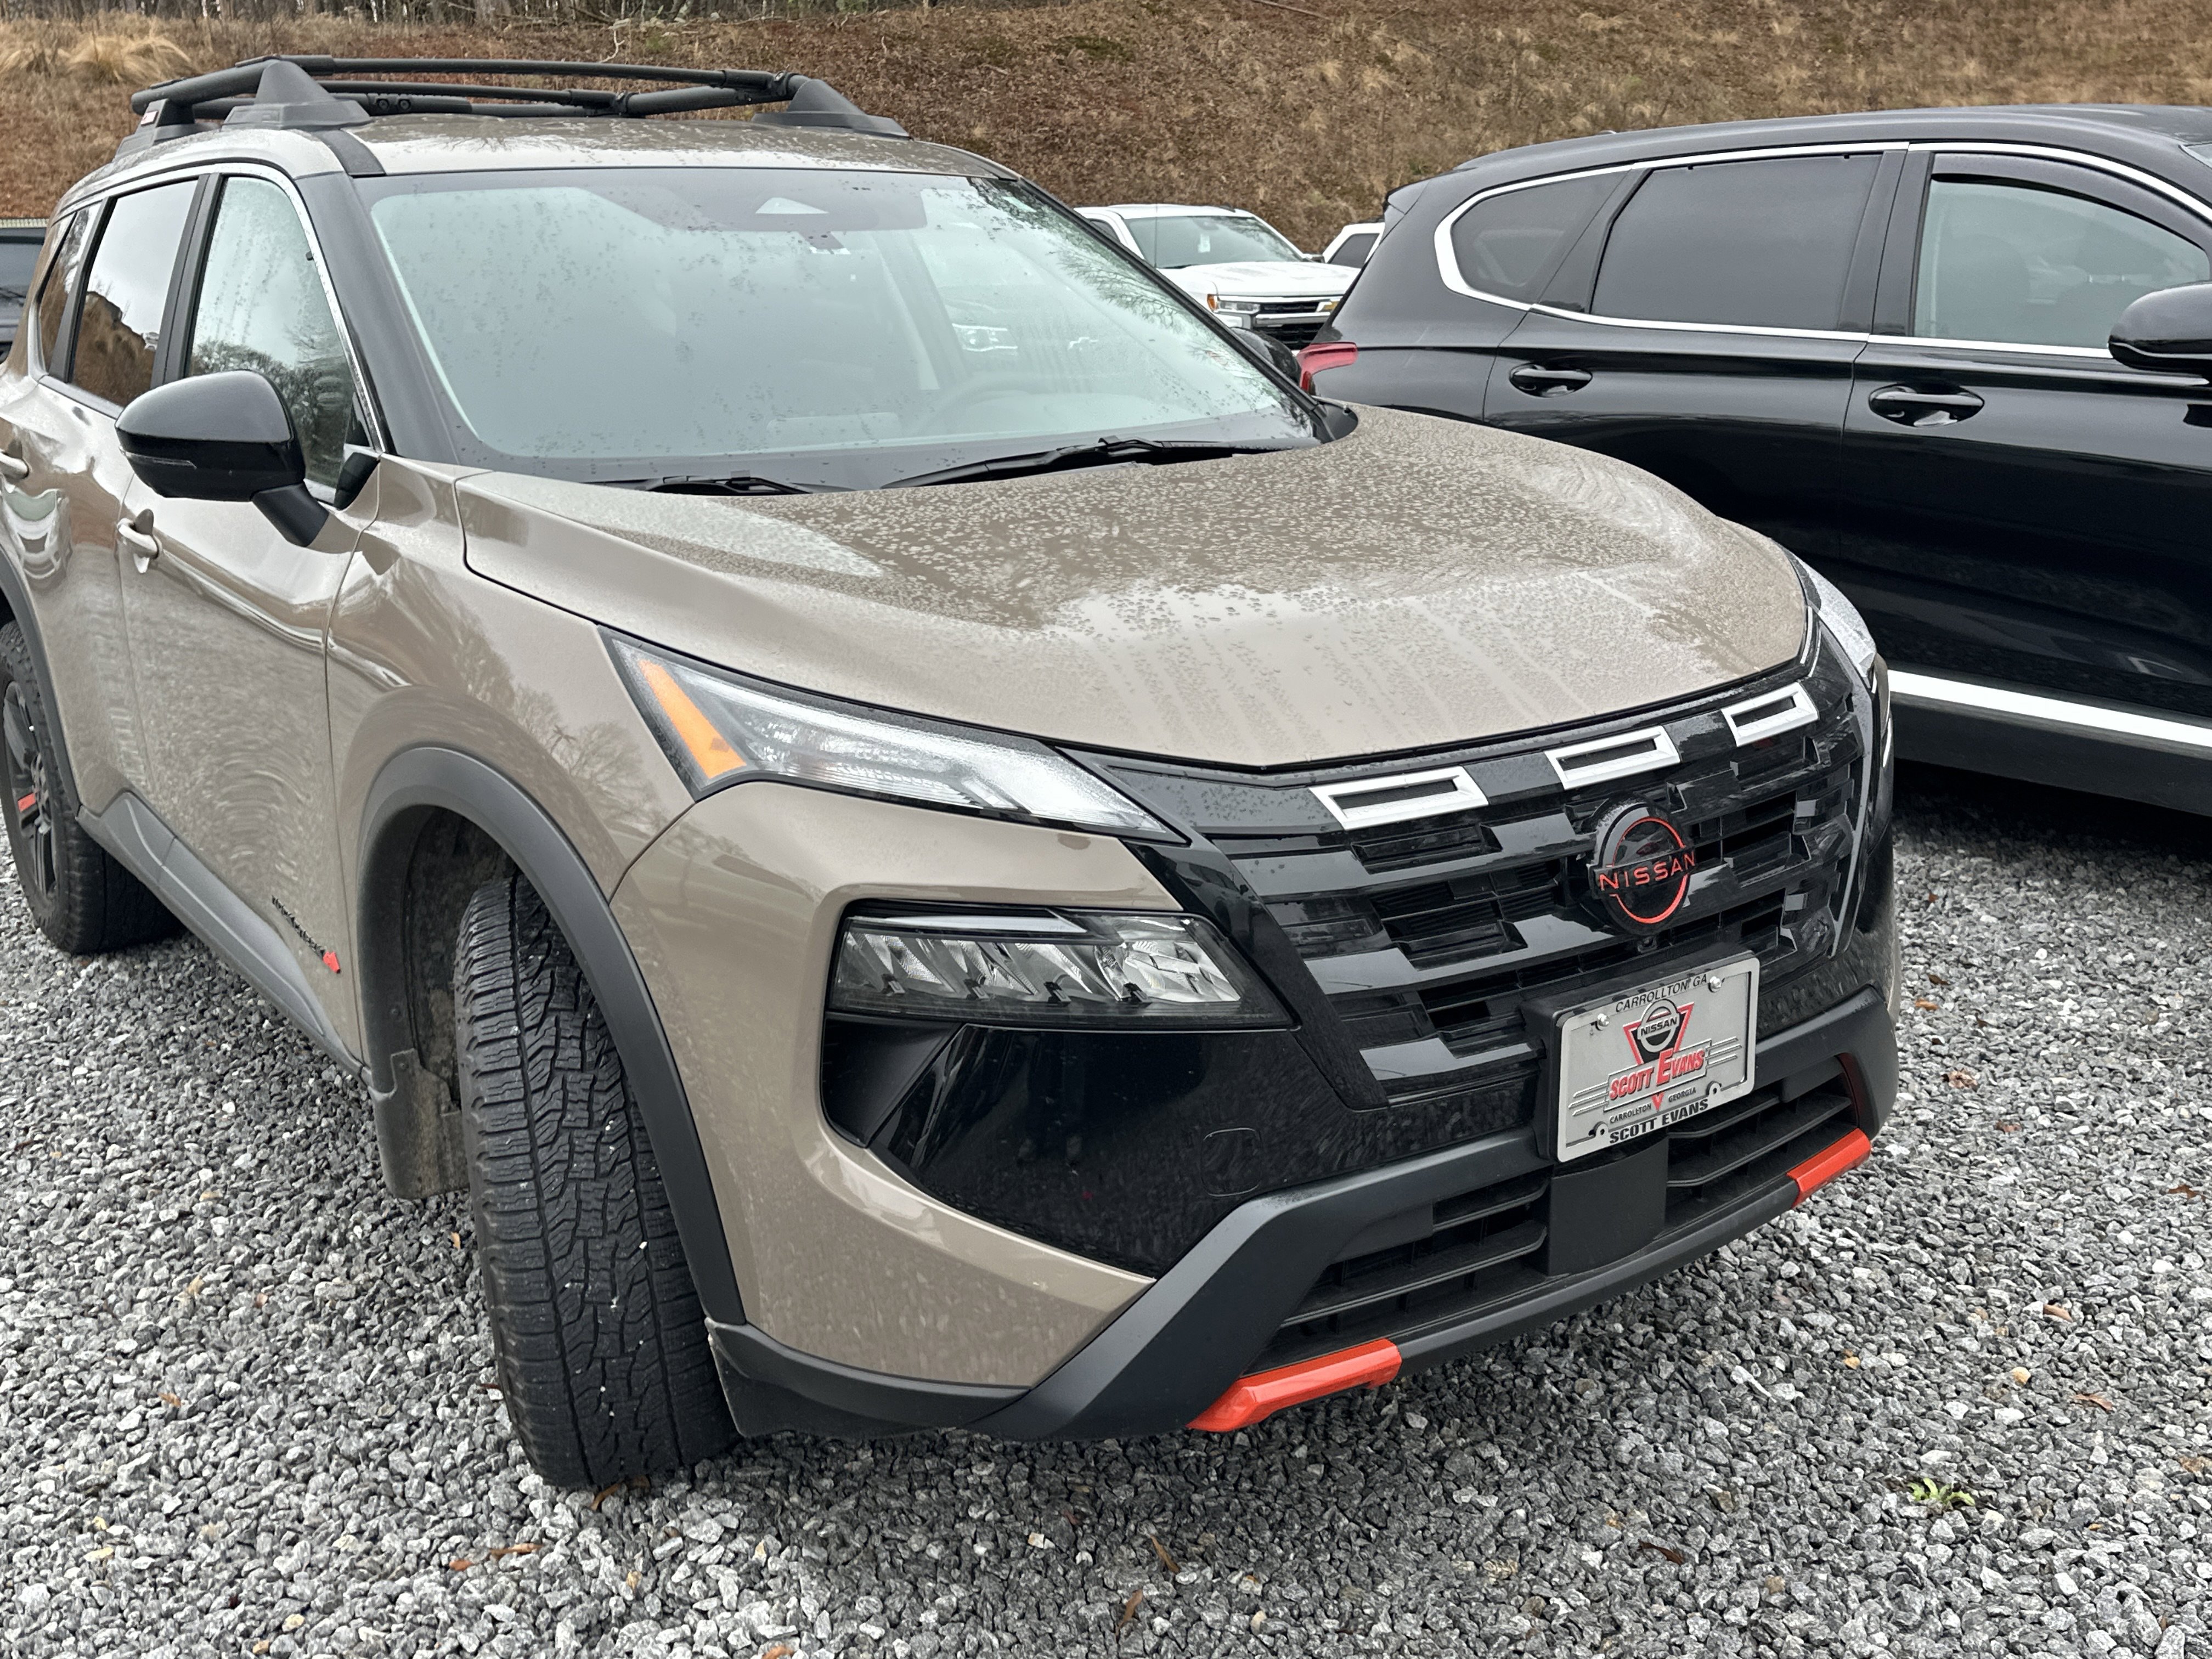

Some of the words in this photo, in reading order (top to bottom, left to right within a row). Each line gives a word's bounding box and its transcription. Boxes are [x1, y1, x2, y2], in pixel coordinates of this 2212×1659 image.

[1599, 851, 1696, 891] NISSAN
[1615, 980, 1688, 1013] CARROLLTON
[1692, 973, 1707, 987] GA
[1640, 1017, 1678, 1036] NISSAN
[1609, 1066, 1655, 1101] SCOTT
[1656, 1047, 1705, 1087] EVANS
[1609, 1103, 1652, 1124] CARROLLTON
[1668, 1087, 1696, 1103] GEORGIA
[1609, 1118, 1657, 1144] SCOTT
[1662, 1098, 1708, 1125] EVANS
